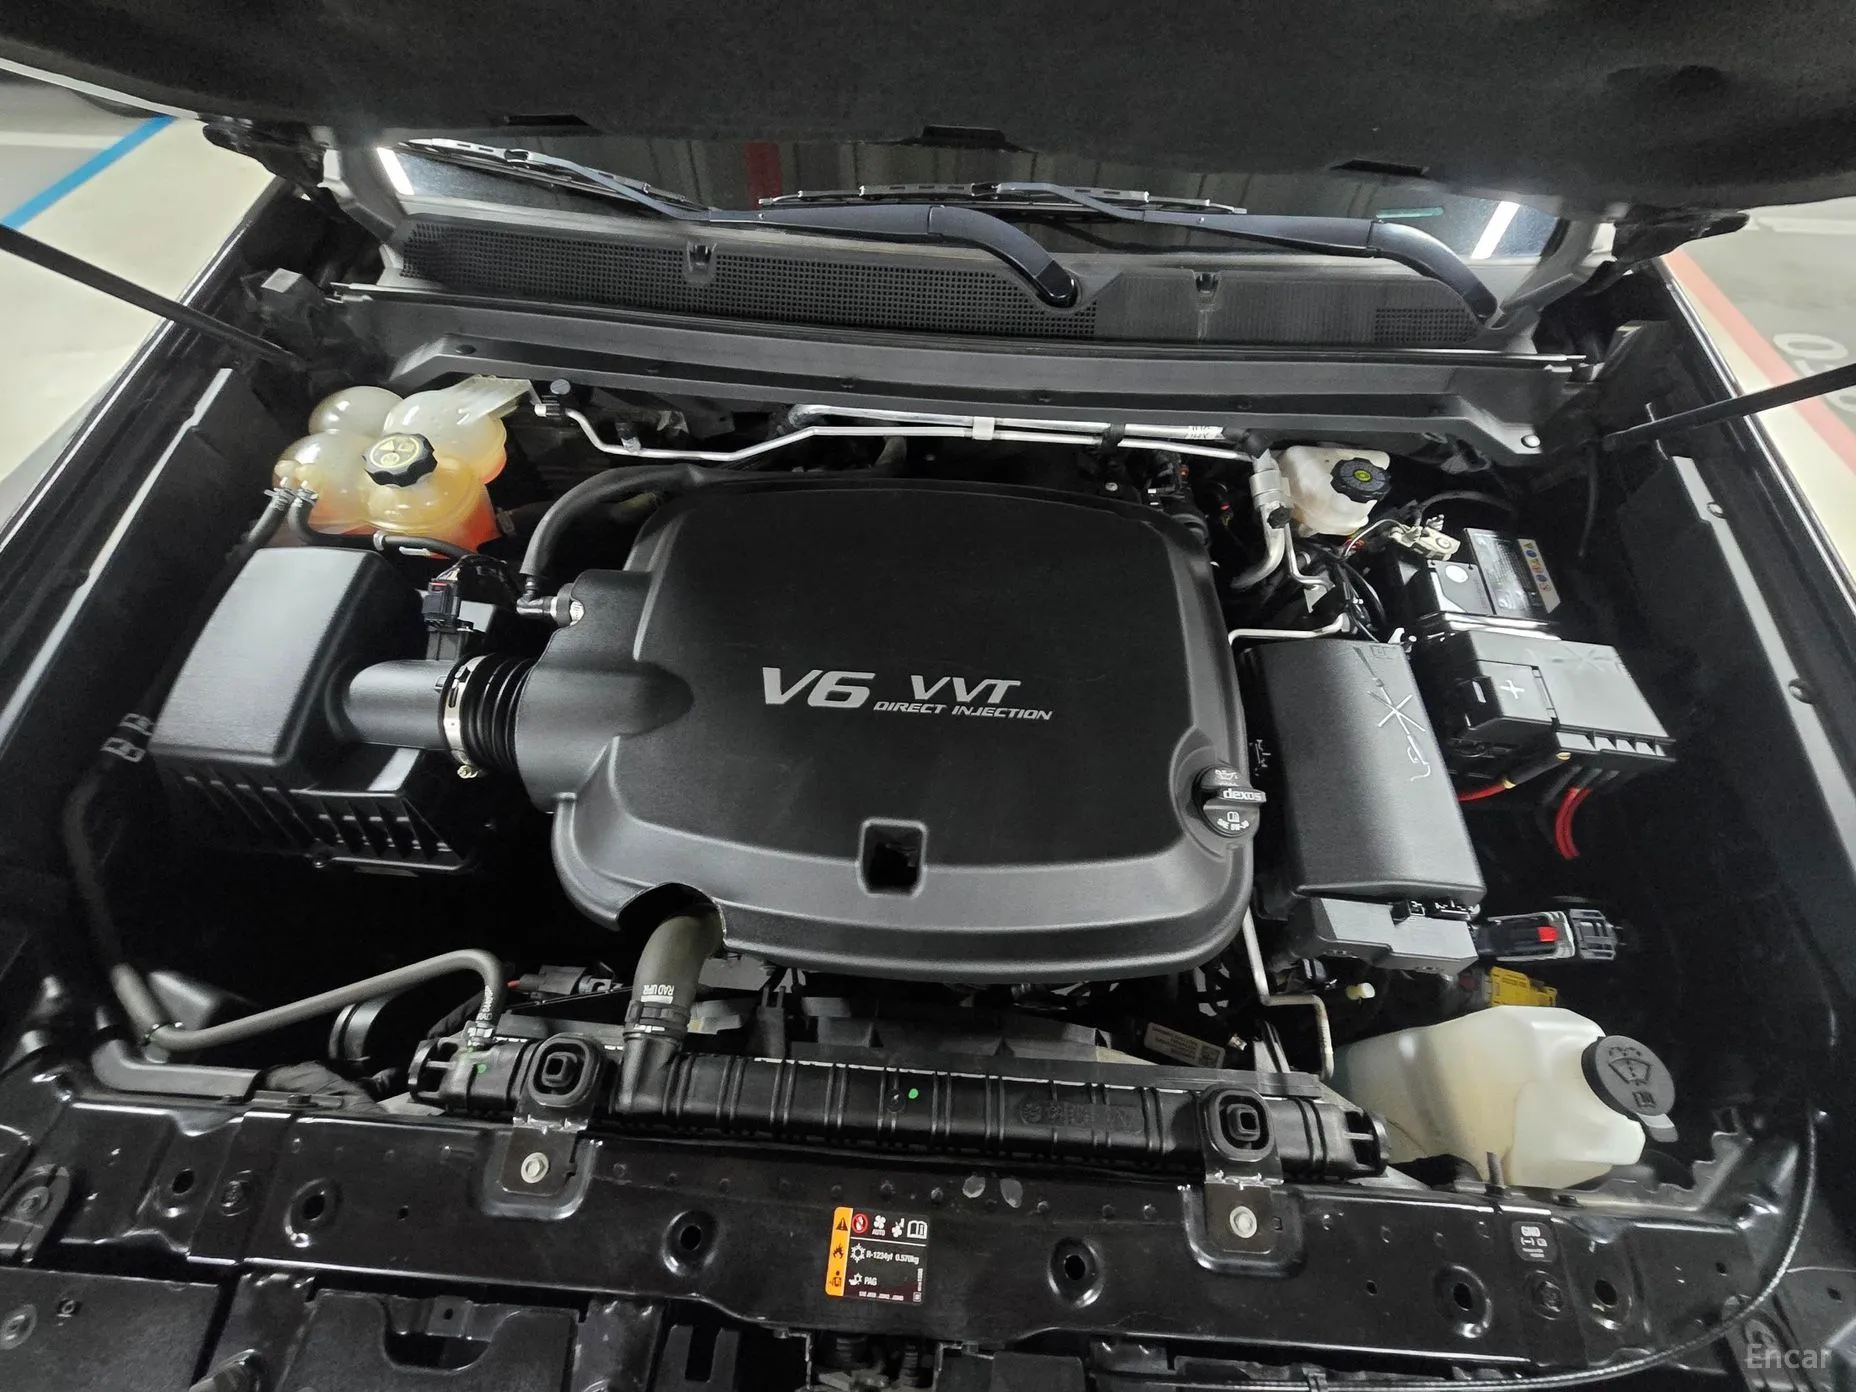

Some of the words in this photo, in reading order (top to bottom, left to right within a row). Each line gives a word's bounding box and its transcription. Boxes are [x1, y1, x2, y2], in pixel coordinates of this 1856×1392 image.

[762, 667, 876, 708] V6
[910, 674, 1022, 704] VVT
[873, 701, 947, 714] DIRECT
[951, 706, 1053, 721] INJECTION
[1222, 787, 1266, 803] dexos
[657, 984, 675, 996] RAD
[866, 1250, 893, 1262] R-1234yf
[864, 1276, 878, 1286] PAG
